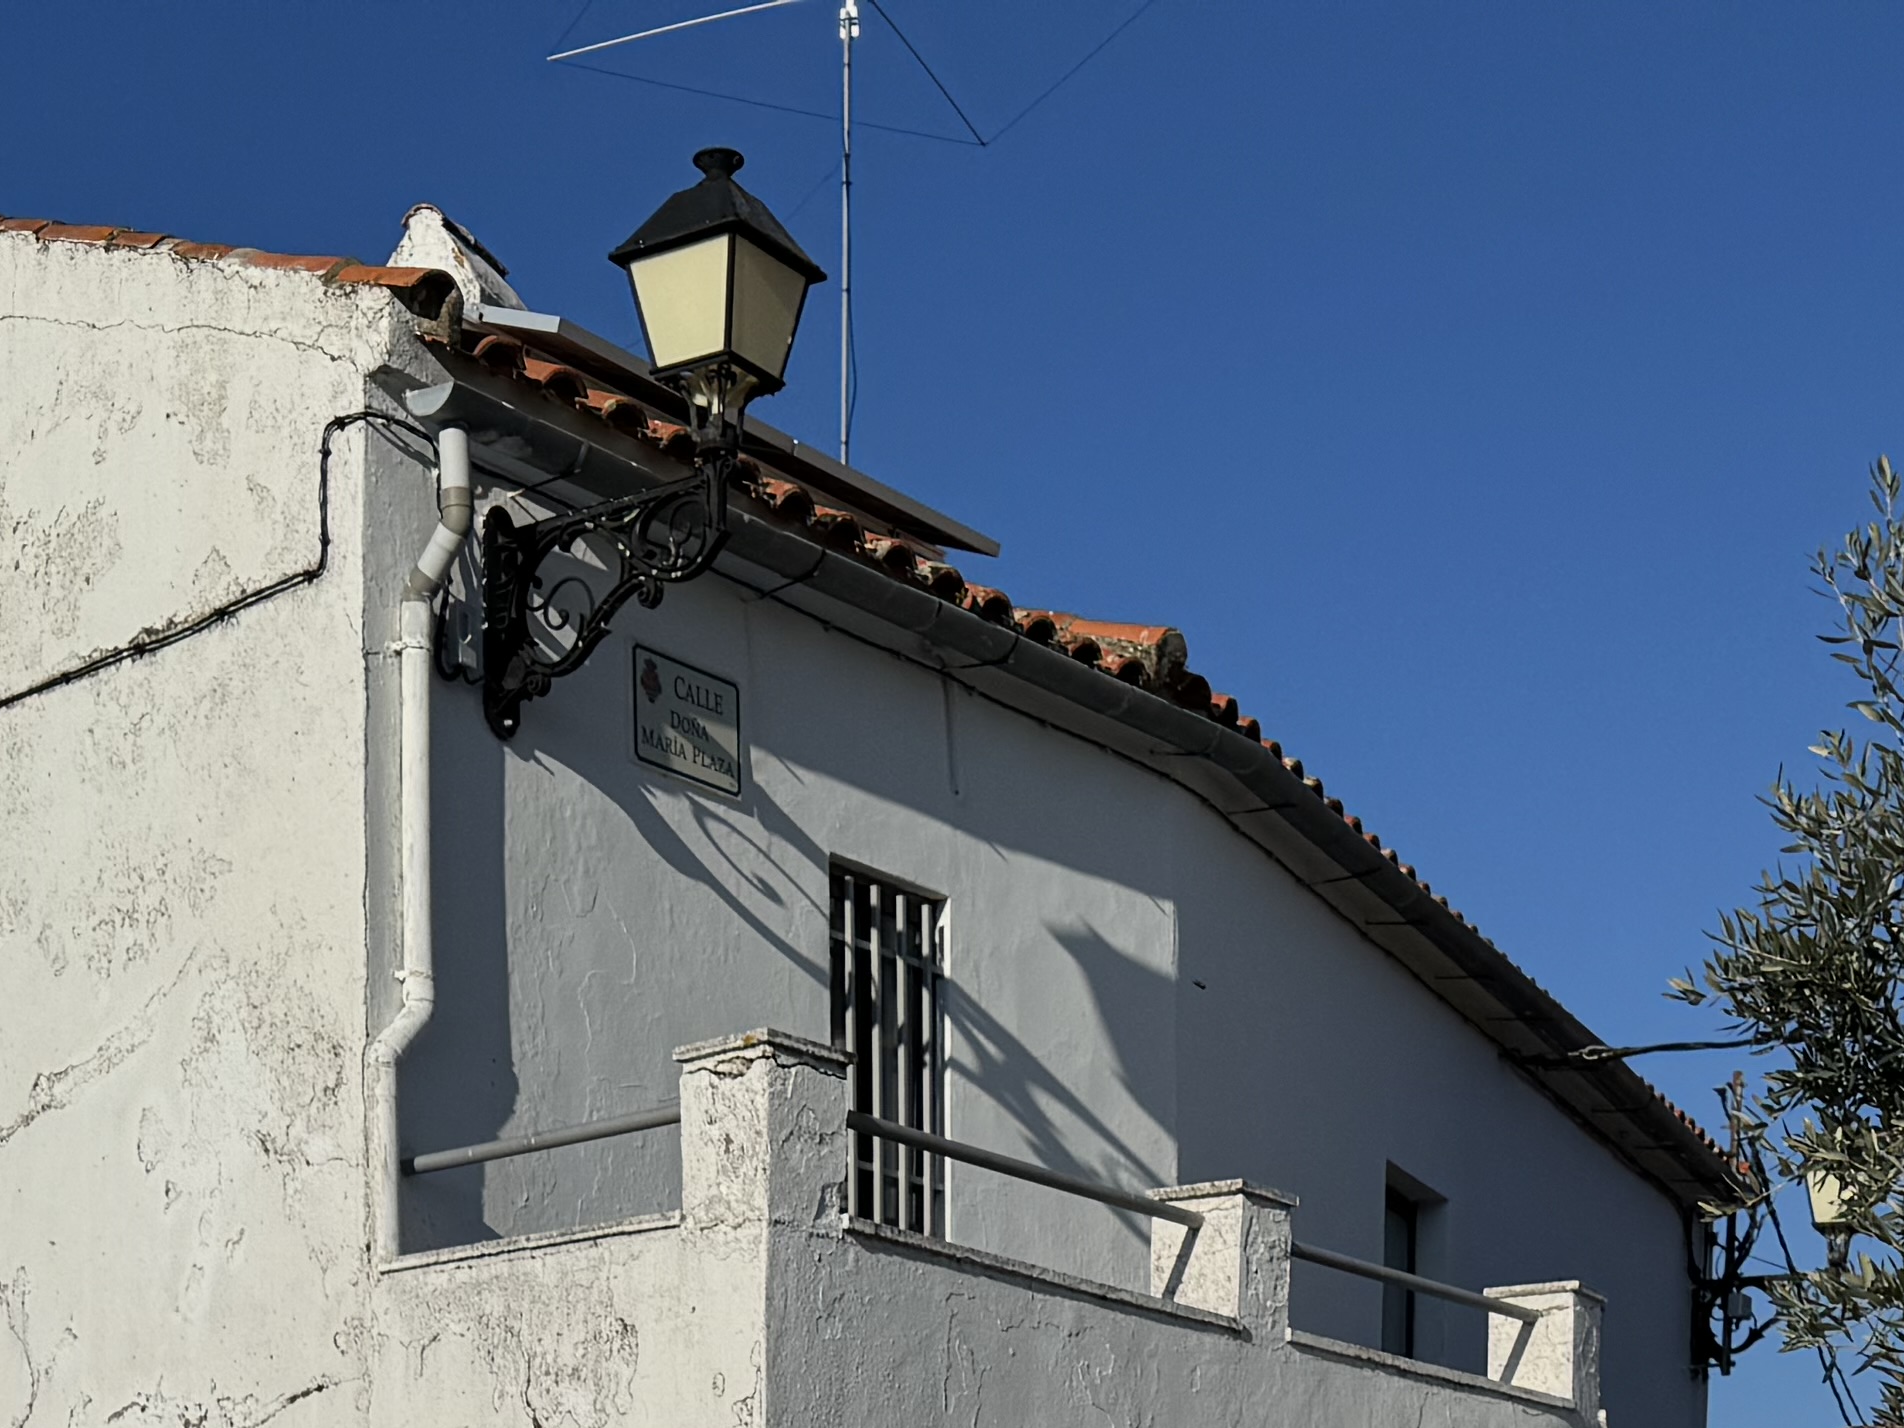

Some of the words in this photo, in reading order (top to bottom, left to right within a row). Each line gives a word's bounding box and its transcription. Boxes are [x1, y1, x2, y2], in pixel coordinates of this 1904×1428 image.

[674, 675, 724, 716] CALLE
[670, 709, 710, 742] DOÑA
[641, 725, 687, 761] MARÍA
[693, 745, 736, 780] PLAZA
